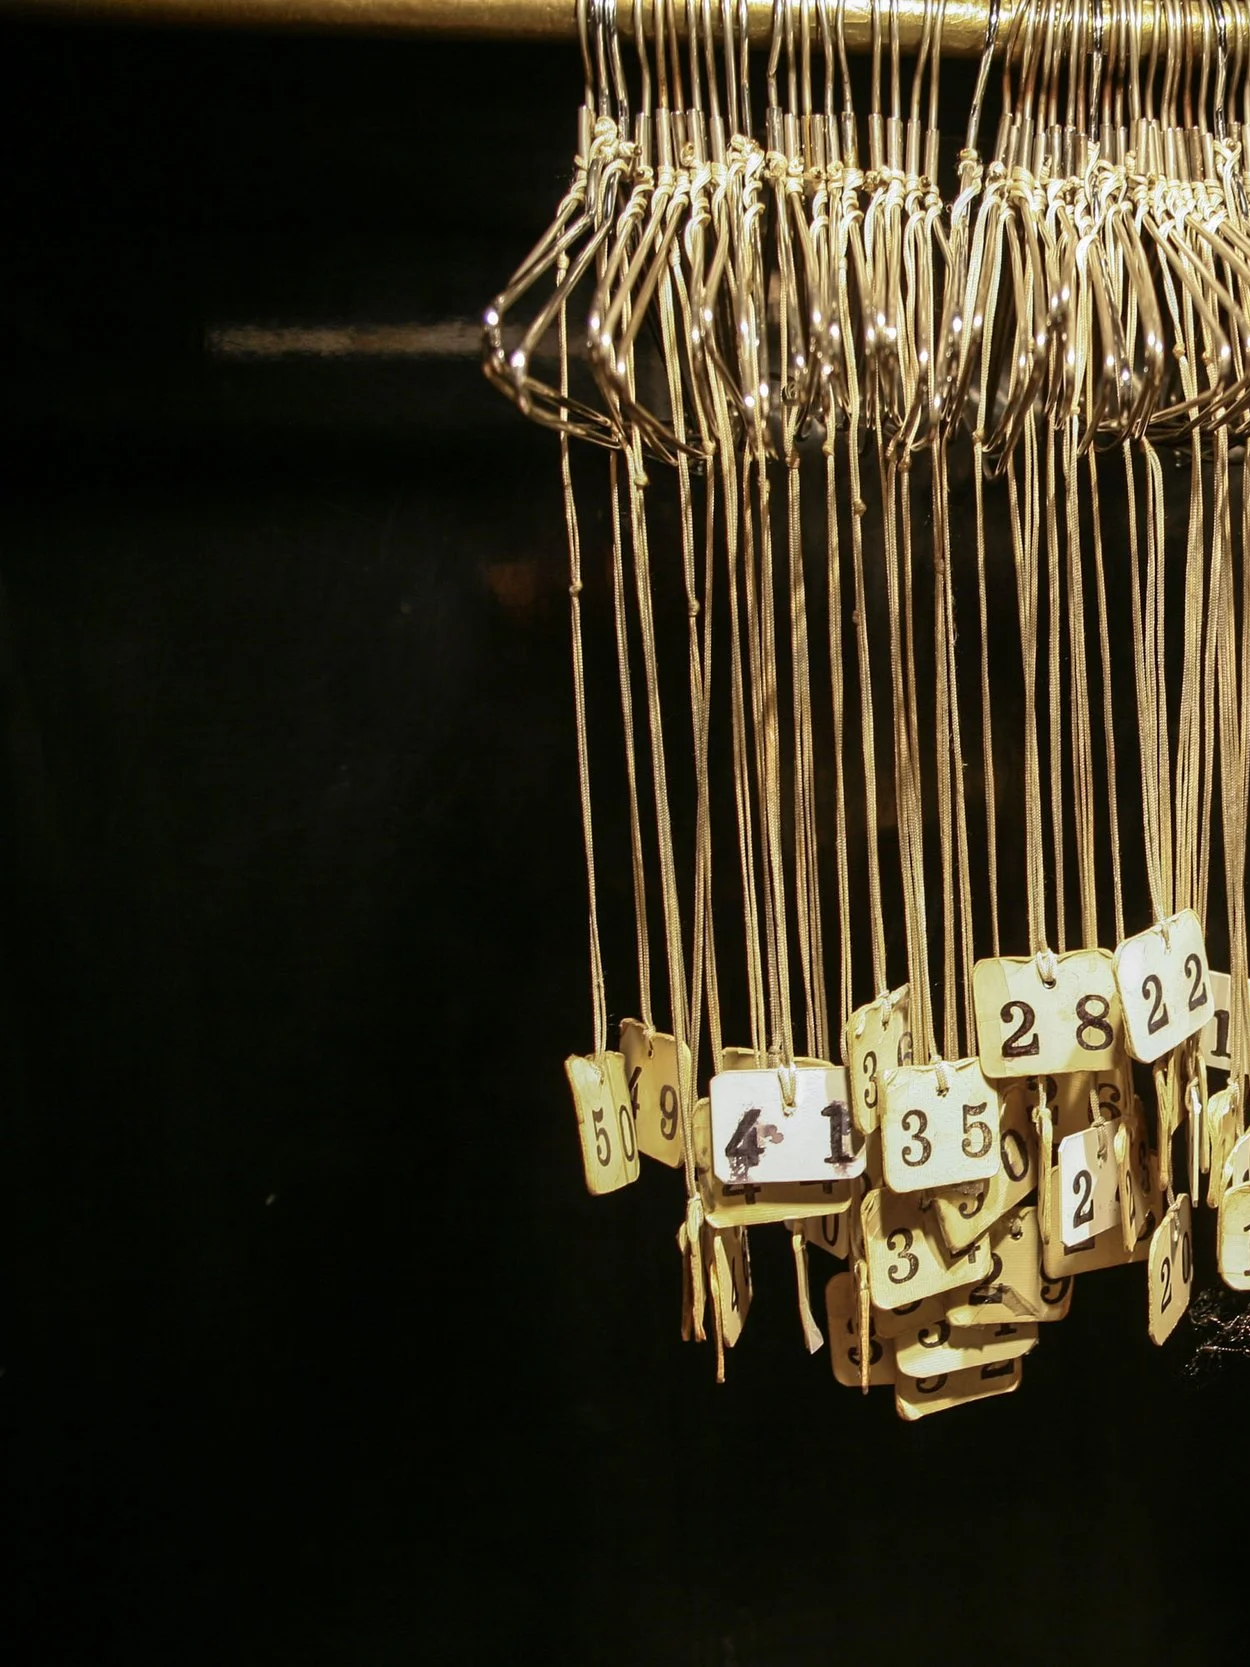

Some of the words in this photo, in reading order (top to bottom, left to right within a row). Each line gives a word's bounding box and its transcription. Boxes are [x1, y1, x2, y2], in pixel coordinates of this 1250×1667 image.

[1000, 994, 1114, 1059] 28
[1142, 952, 1208, 1036] 22
[592, 1103, 636, 1168] 50
[725, 1099, 857, 1168] 41
[901, 1101, 993, 1168] 35
[1160, 1231, 1192, 1315] 20
